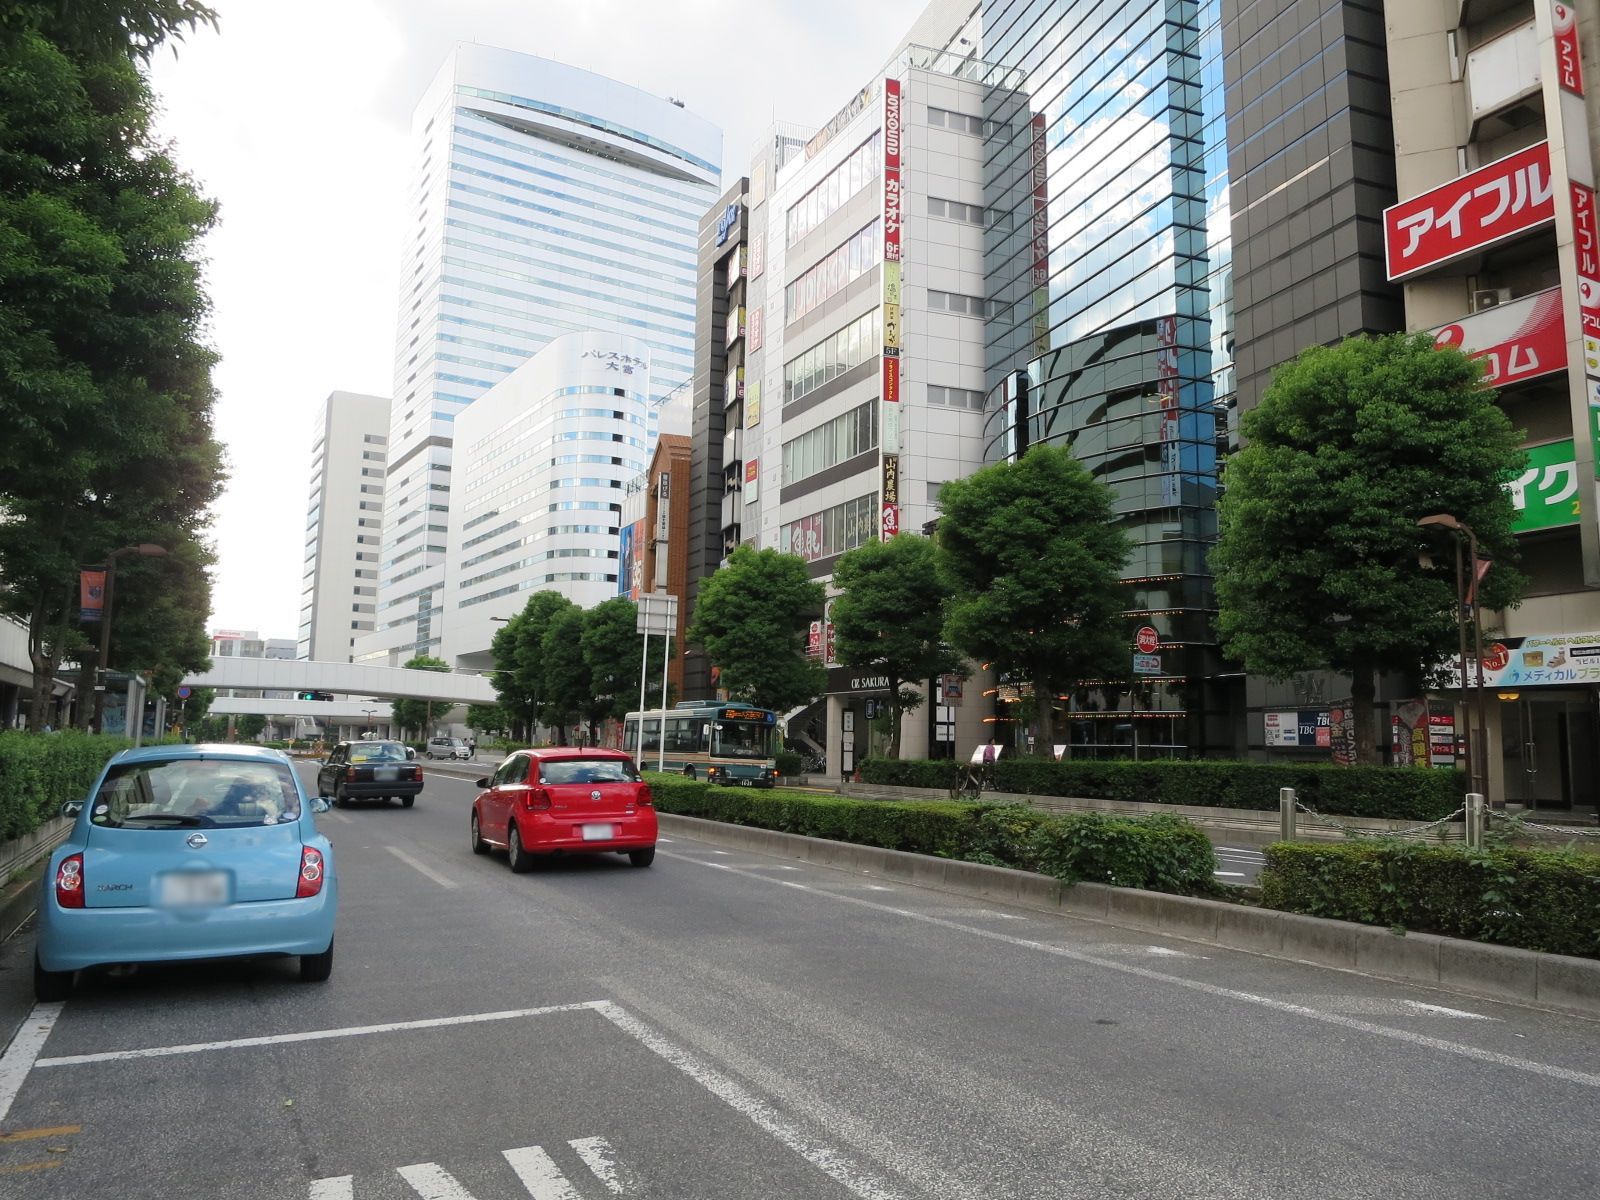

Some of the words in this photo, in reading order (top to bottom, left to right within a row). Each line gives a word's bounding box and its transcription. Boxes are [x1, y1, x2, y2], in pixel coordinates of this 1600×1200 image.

[886, 92, 899, 156] JOYSOUND
[885, 178, 900, 234] カラオケ
[1397, 163, 1554, 258] アイフル
[1574, 187, 1596, 275] アイフル
[886, 241, 900, 254] 6F
[581, 348, 649, 370] パレスホテル
[605, 361, 635, 375] 大宮
[885, 458, 896, 503] 山内農場
[1485, 652, 1505, 669] No.1
[861, 676, 890, 689] SAKURA
[1300, 726, 1315, 734] TBC
